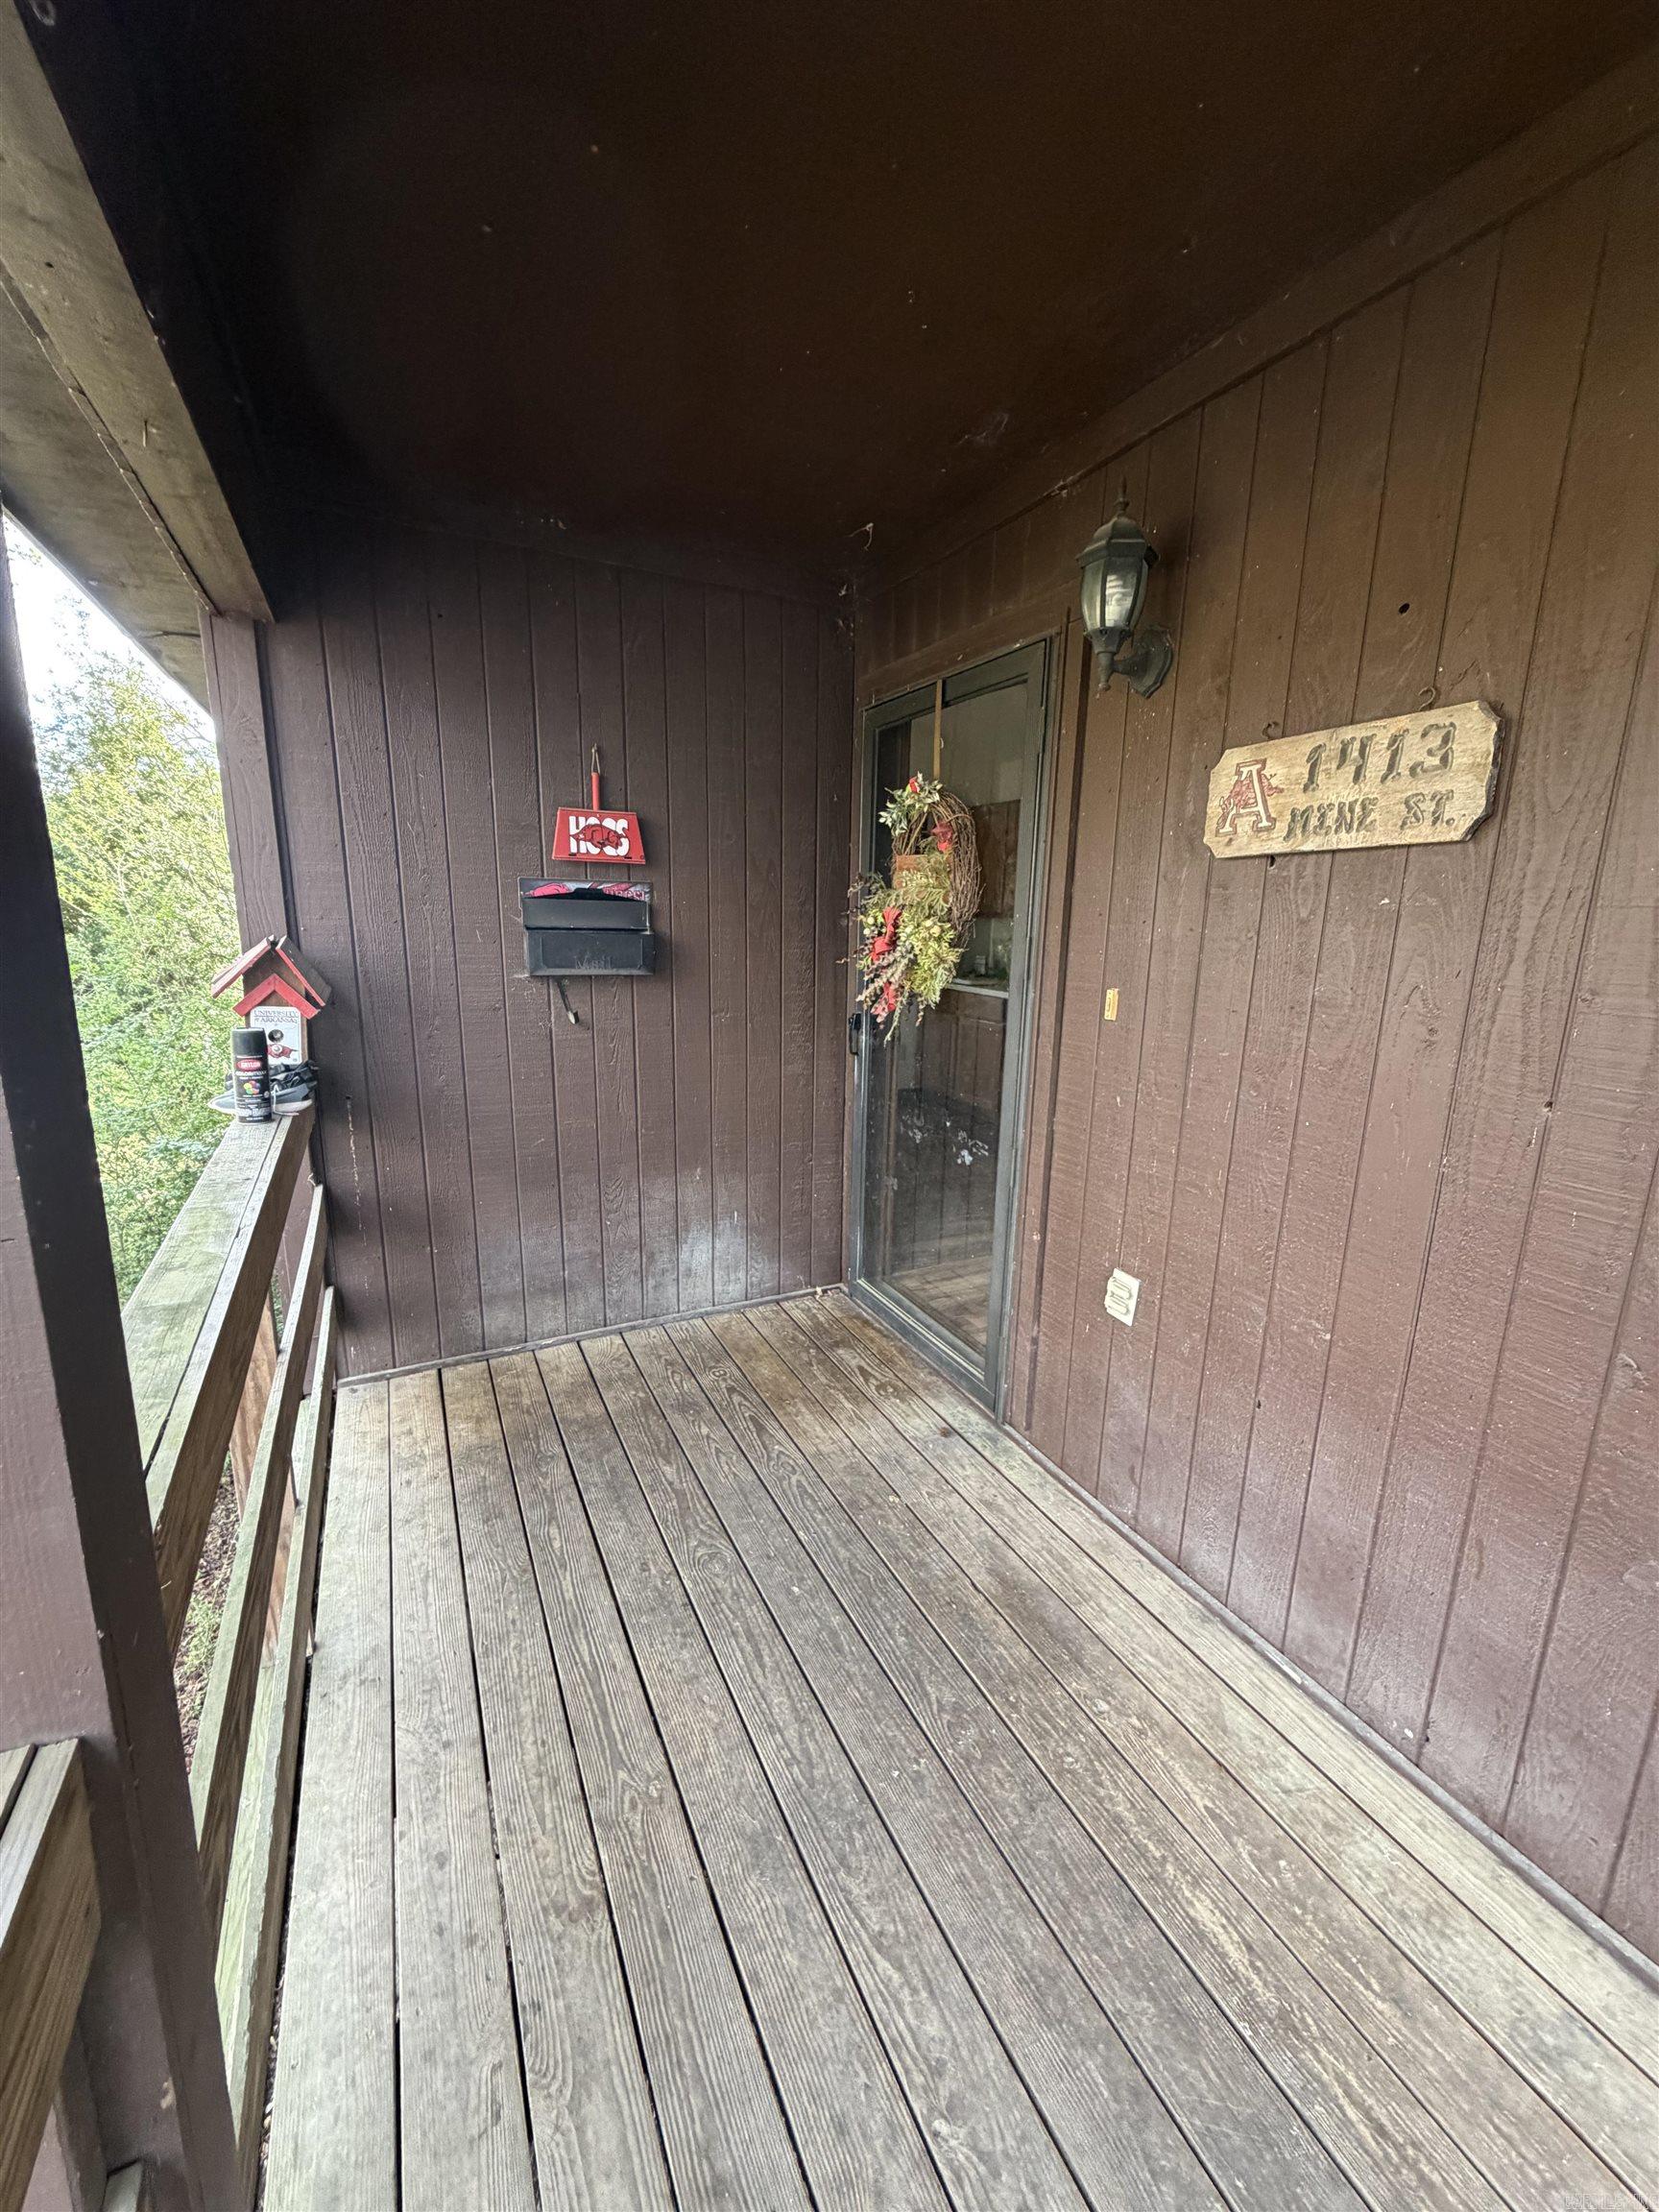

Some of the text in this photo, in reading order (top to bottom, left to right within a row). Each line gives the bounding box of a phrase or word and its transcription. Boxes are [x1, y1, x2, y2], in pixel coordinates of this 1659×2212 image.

[1303, 721, 1457, 793] 1413
[1215, 757, 1277, 837] A
[1283, 788, 1455, 842] MINE ST.
